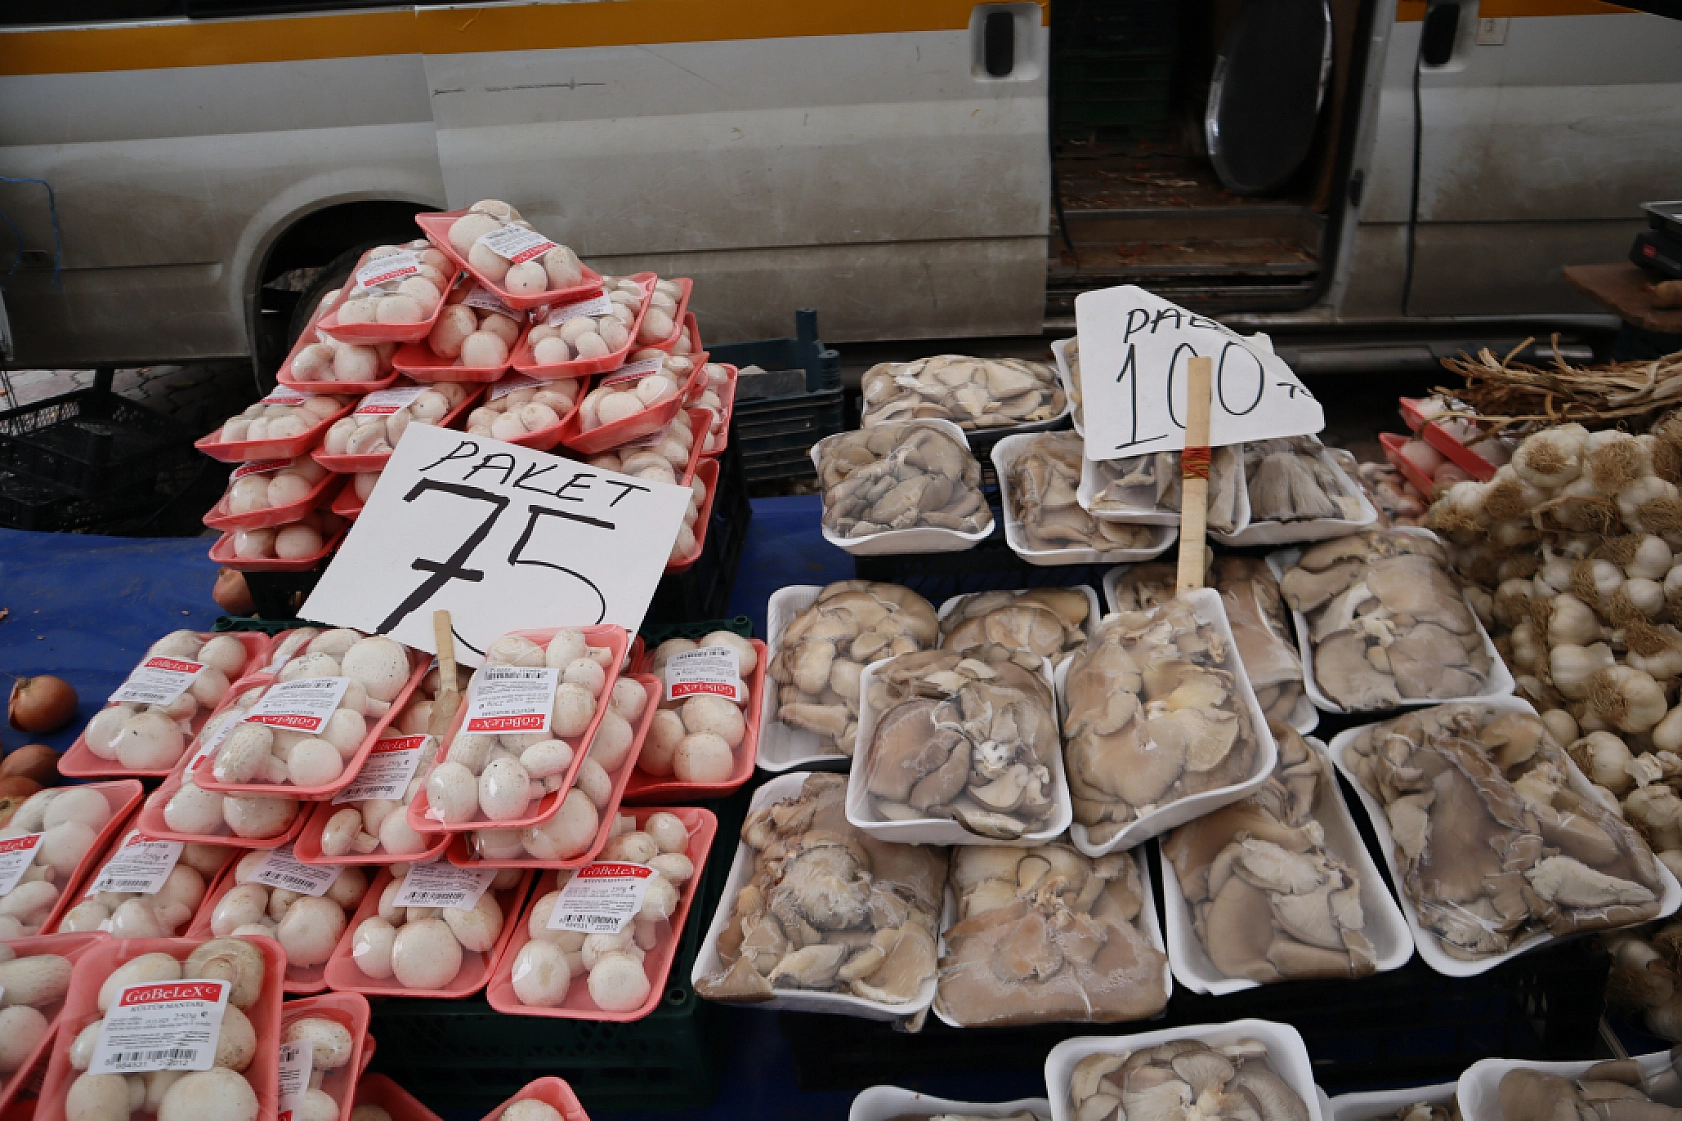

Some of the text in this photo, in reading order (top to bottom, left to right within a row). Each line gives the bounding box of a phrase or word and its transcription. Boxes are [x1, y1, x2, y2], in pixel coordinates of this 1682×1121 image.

[1115, 341, 1265, 450] 100
[419, 440, 651, 508] PAKET
[375, 478, 615, 657] 75
